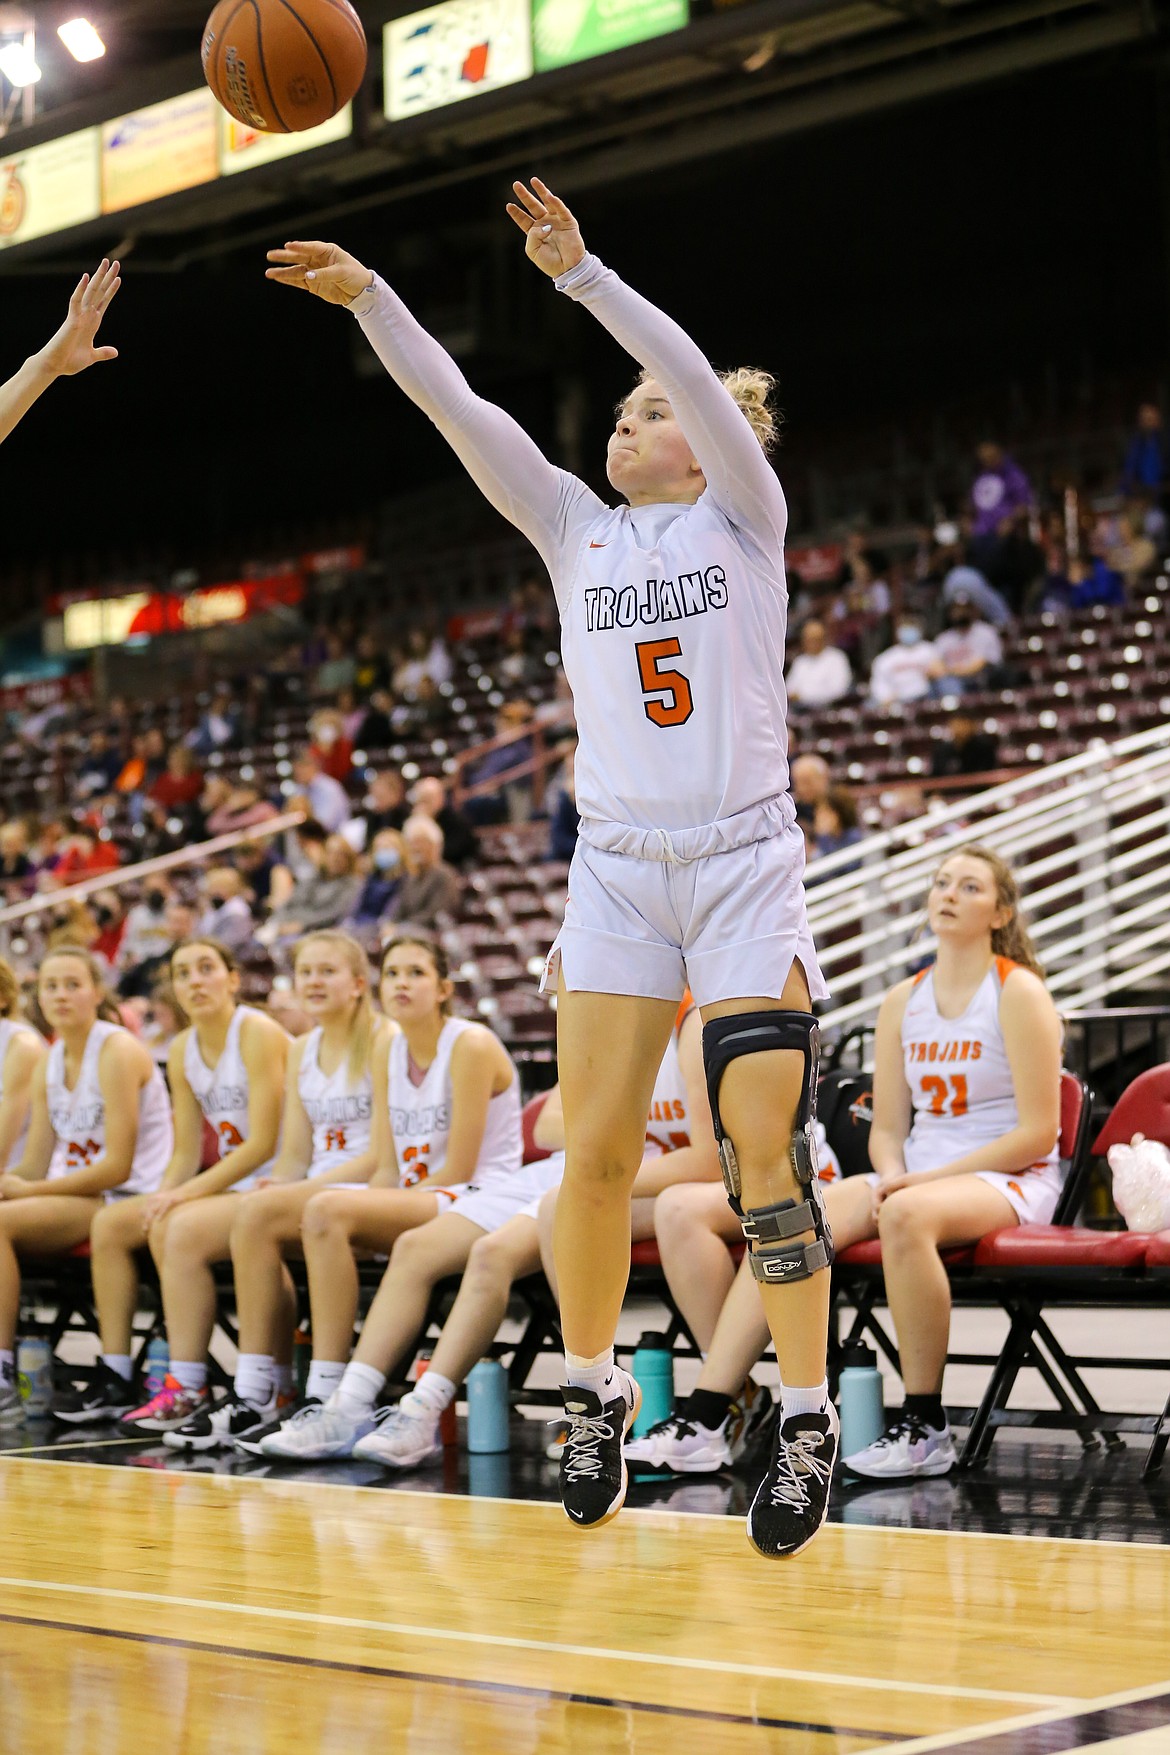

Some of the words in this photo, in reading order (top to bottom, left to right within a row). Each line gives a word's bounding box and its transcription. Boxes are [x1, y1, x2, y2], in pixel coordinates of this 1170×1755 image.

[585, 564, 729, 632] TROJANS
[635, 636, 694, 728] 5
[909, 1040, 982, 1062] TROJANS
[648, 1098, 686, 1121] ANS
